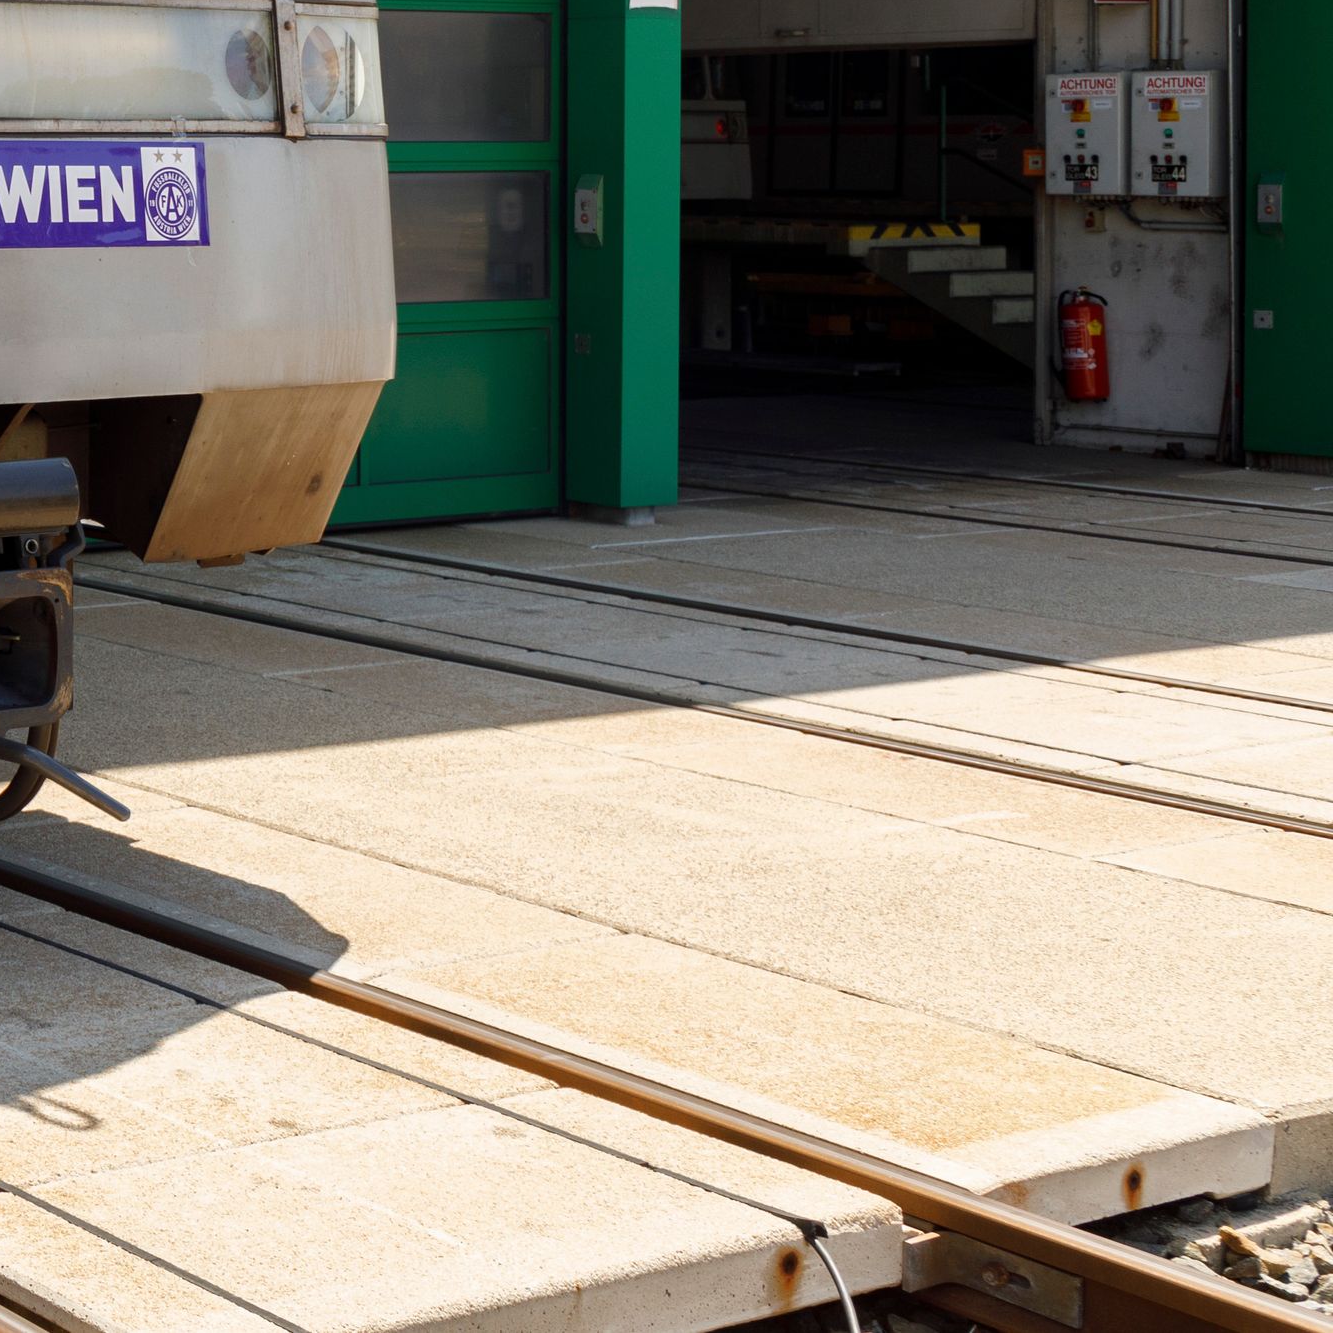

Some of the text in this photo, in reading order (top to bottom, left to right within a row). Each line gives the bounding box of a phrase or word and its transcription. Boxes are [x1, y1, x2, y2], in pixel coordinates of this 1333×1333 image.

[1060, 78, 1116, 90] ACHTUNG!
[1147, 76, 1206, 88] ACHTUNG!
[1085, 166, 1098, 179] 43
[1172, 166, 1186, 180] 44
[153, 215, 192, 234] AUSTRIA WIEN
